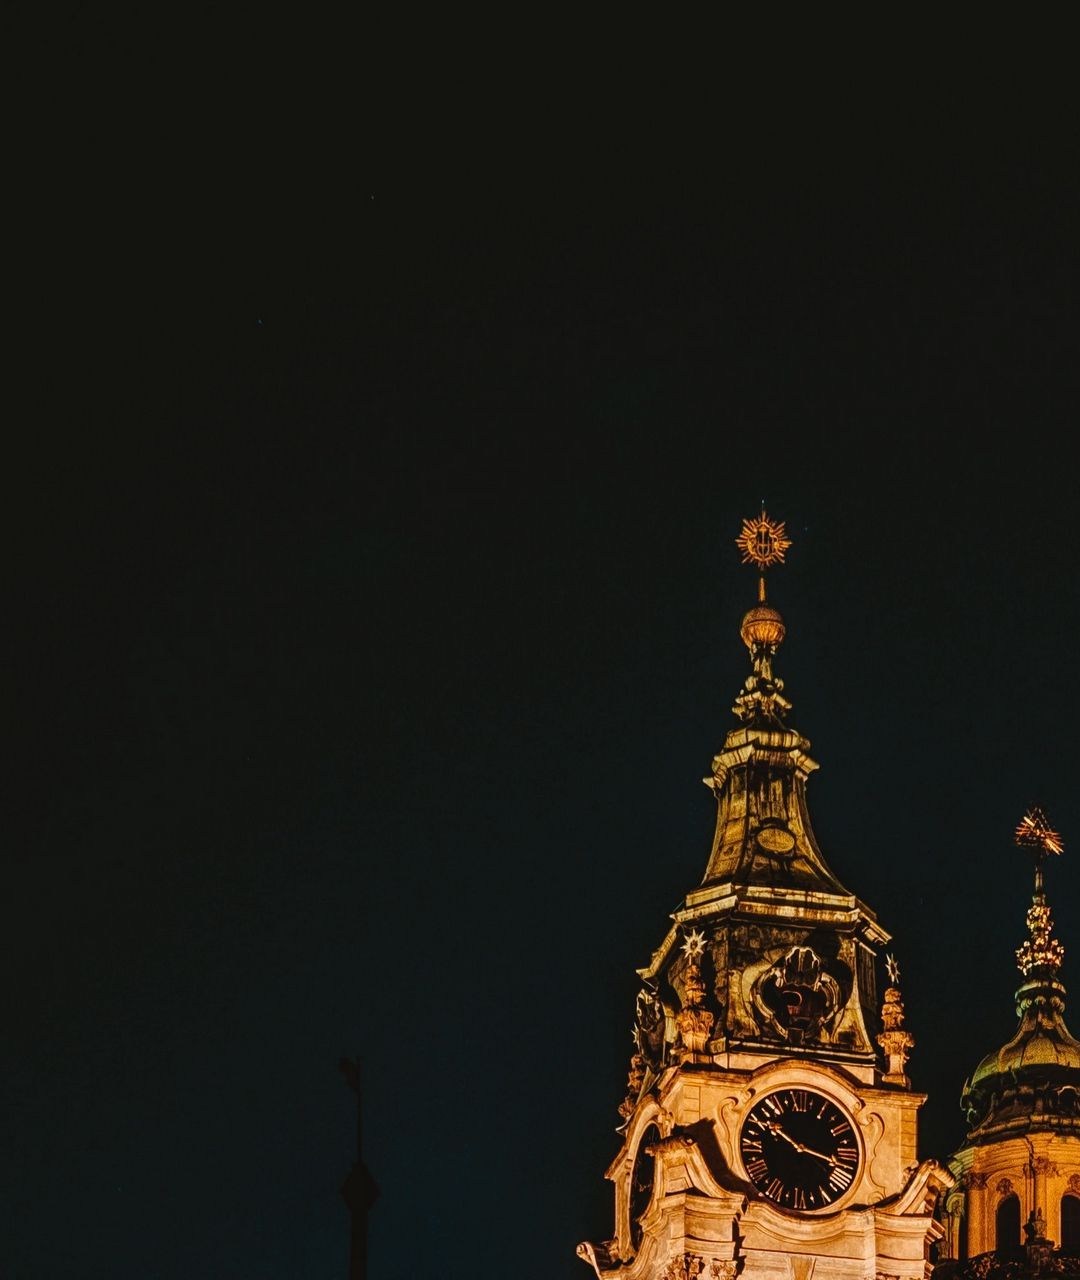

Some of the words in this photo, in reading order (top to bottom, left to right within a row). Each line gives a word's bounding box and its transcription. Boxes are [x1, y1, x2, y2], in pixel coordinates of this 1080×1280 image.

[789, 1090, 808, 1113] XII
[830, 1121, 851, 1137] II
[743, 1138, 762, 1153] IX
[837, 1147, 857, 1163] III
[794, 1187, 807, 1209] VI
